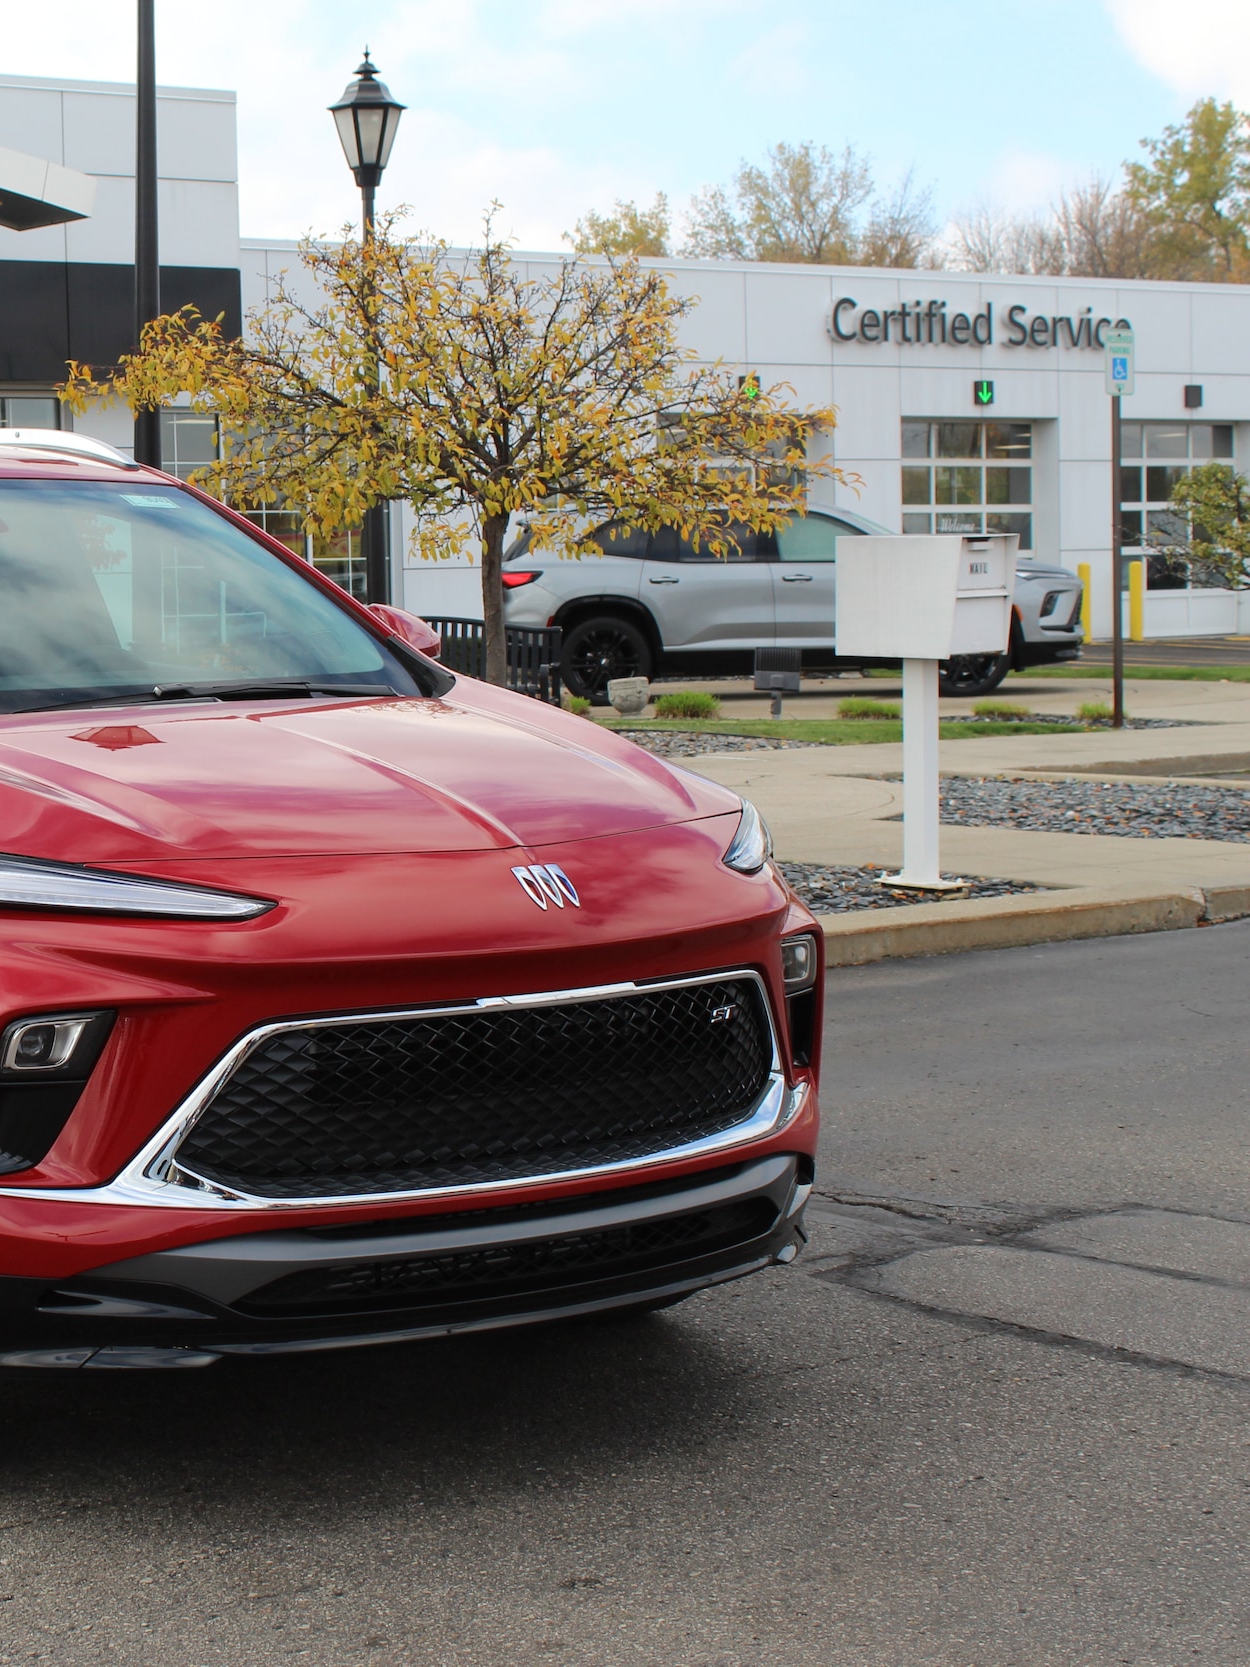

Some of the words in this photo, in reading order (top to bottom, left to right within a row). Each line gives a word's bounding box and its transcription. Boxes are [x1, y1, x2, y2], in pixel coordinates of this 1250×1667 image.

[832, 297, 992, 345] Certified
[940, 518, 976, 532] Welcome
[969, 562, 988, 574] MAIL
[710, 1003, 737, 1024] ST
